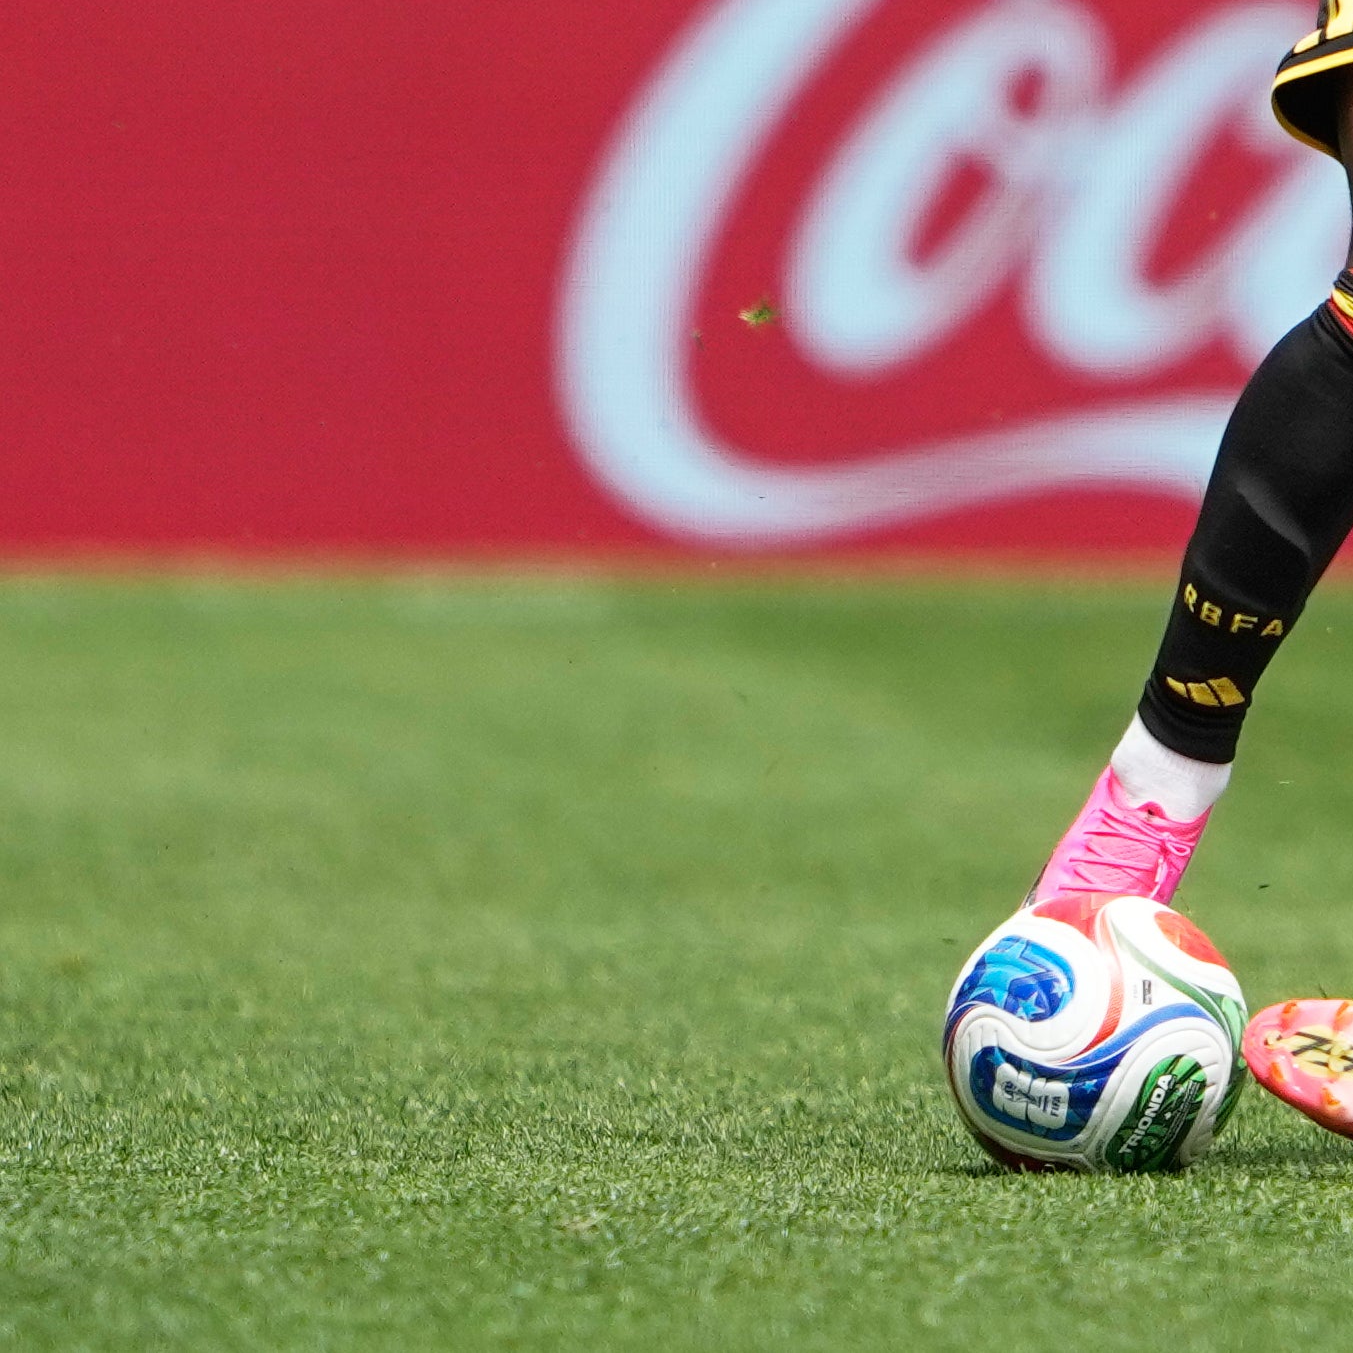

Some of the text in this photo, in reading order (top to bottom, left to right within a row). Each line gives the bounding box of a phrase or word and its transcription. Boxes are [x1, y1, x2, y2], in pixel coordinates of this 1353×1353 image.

[1183, 582, 1284, 637] RBFA
[1050, 1095, 1062, 1118] FIFA
[1118, 1074, 1173, 1154] TRIONDA
